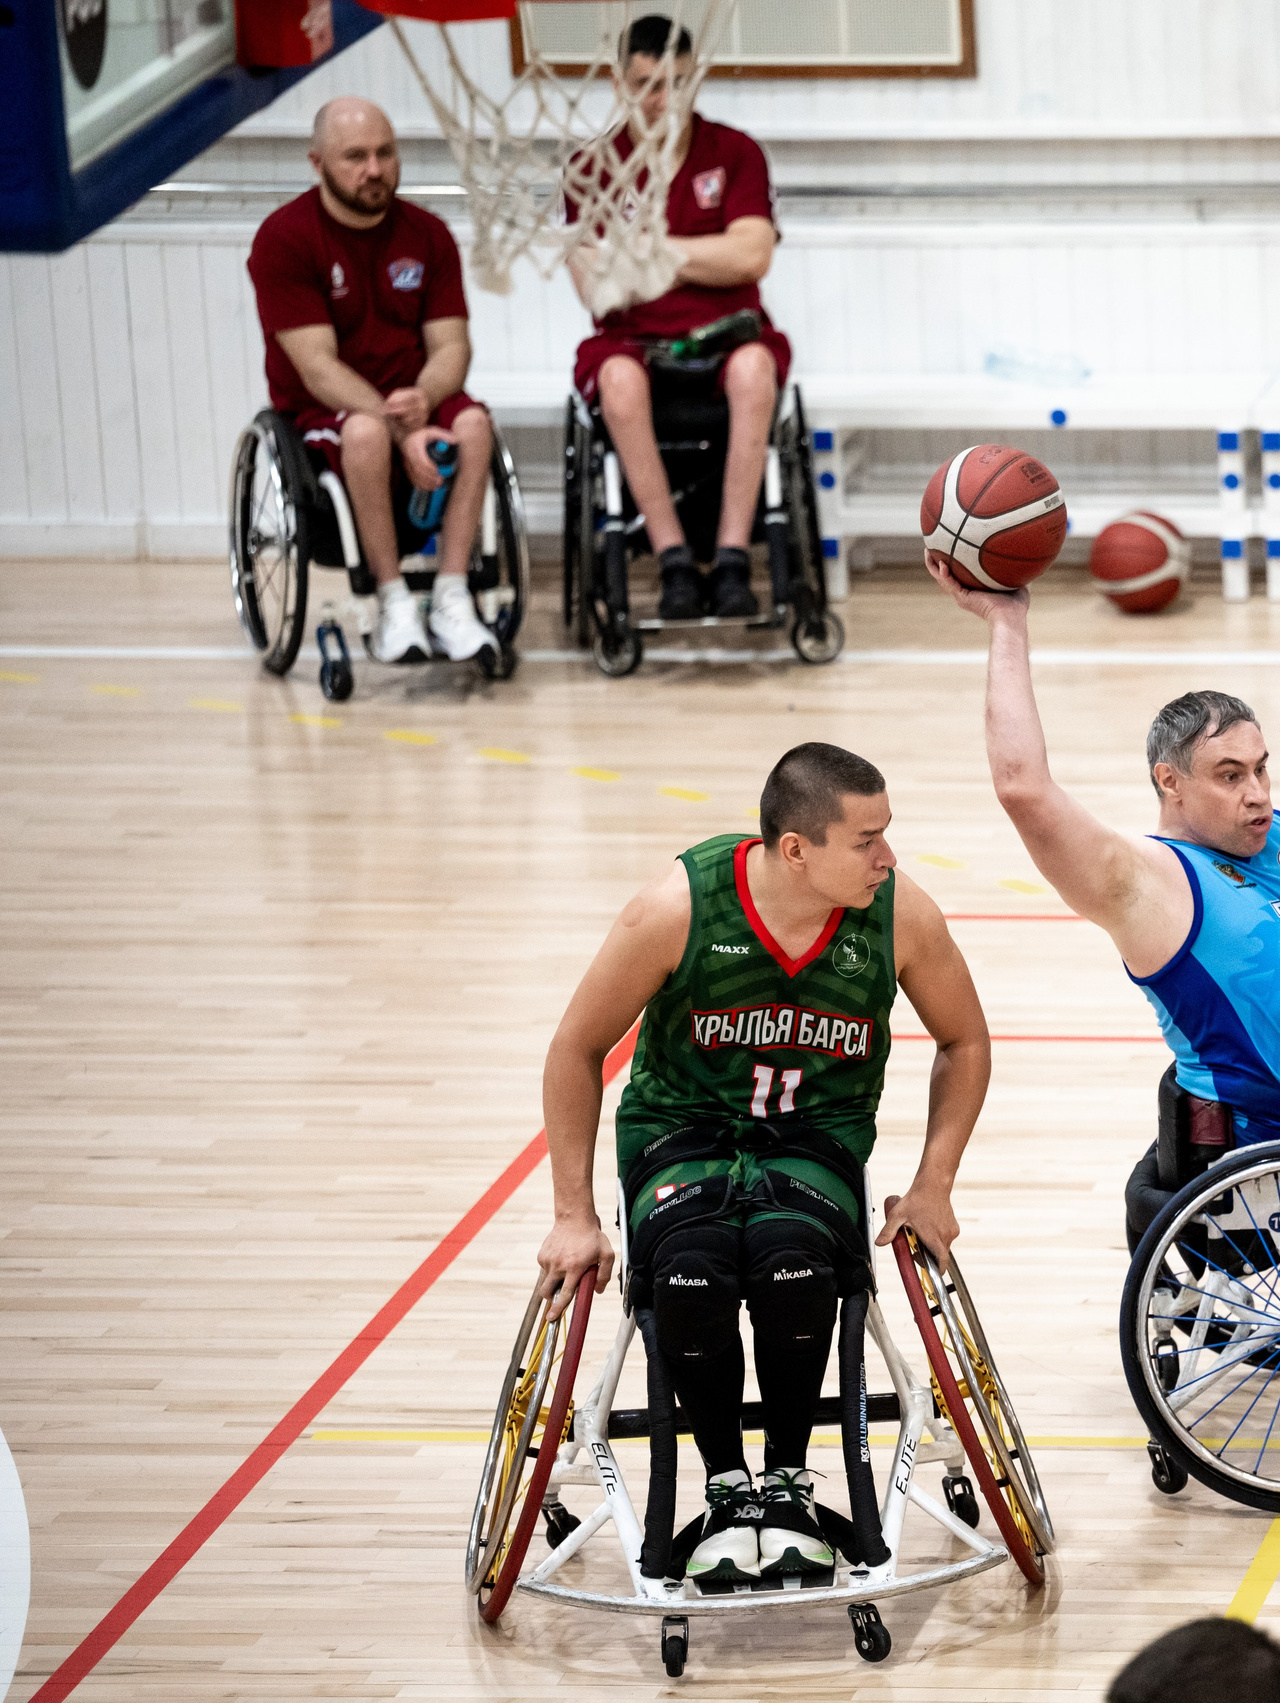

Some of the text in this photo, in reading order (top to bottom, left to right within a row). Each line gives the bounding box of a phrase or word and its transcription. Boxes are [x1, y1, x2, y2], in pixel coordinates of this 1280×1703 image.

[711, 943, 750, 955] MAXX
[693, 1008, 869, 1057] КРЫЛЬЯ БАРСА
[751, 1064, 803, 1119] 11
[591, 1442, 618, 1496] ELITE
[896, 1433, 917, 1496] ELITE
[734, 1504, 766, 1519] RGK
